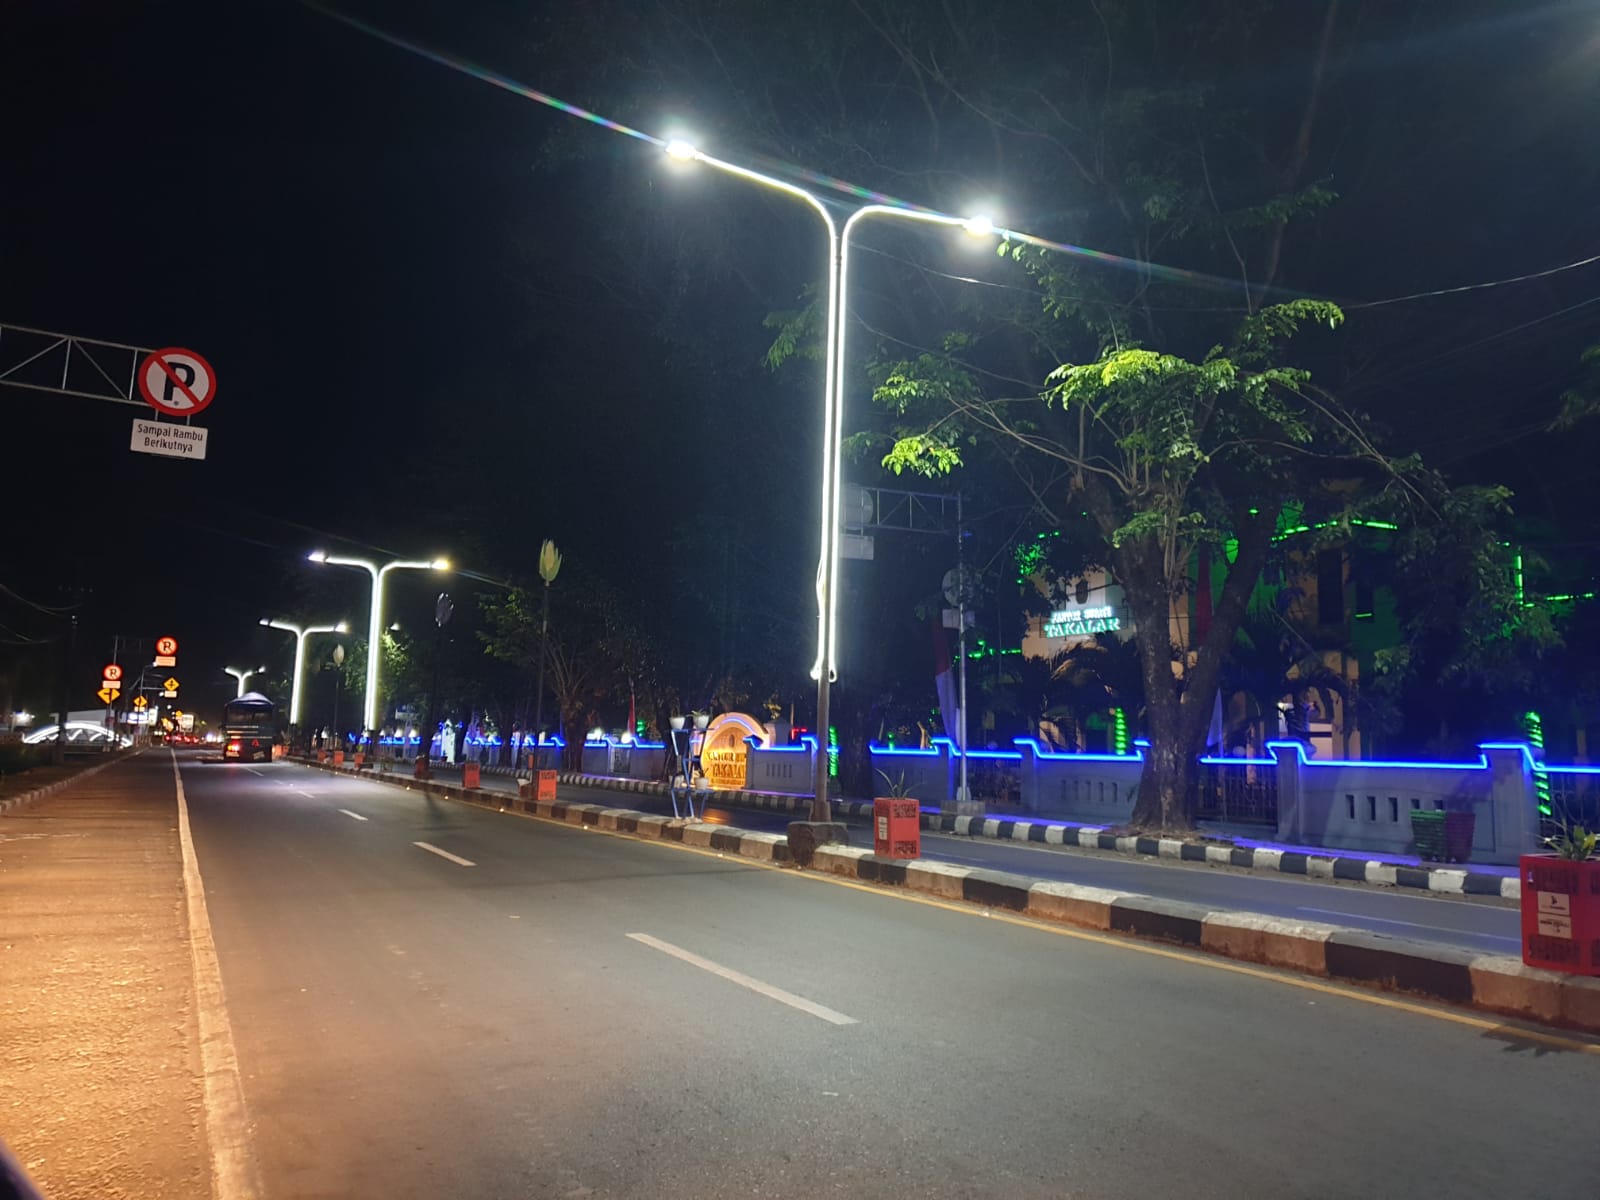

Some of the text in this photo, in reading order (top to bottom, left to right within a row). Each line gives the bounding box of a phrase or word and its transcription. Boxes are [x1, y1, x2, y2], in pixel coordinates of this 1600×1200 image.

[137, 423, 203, 441] Sampai Rambu
[144, 436, 193, 454] Berikutnya
[1044, 617, 1120, 638] TAKALAR
